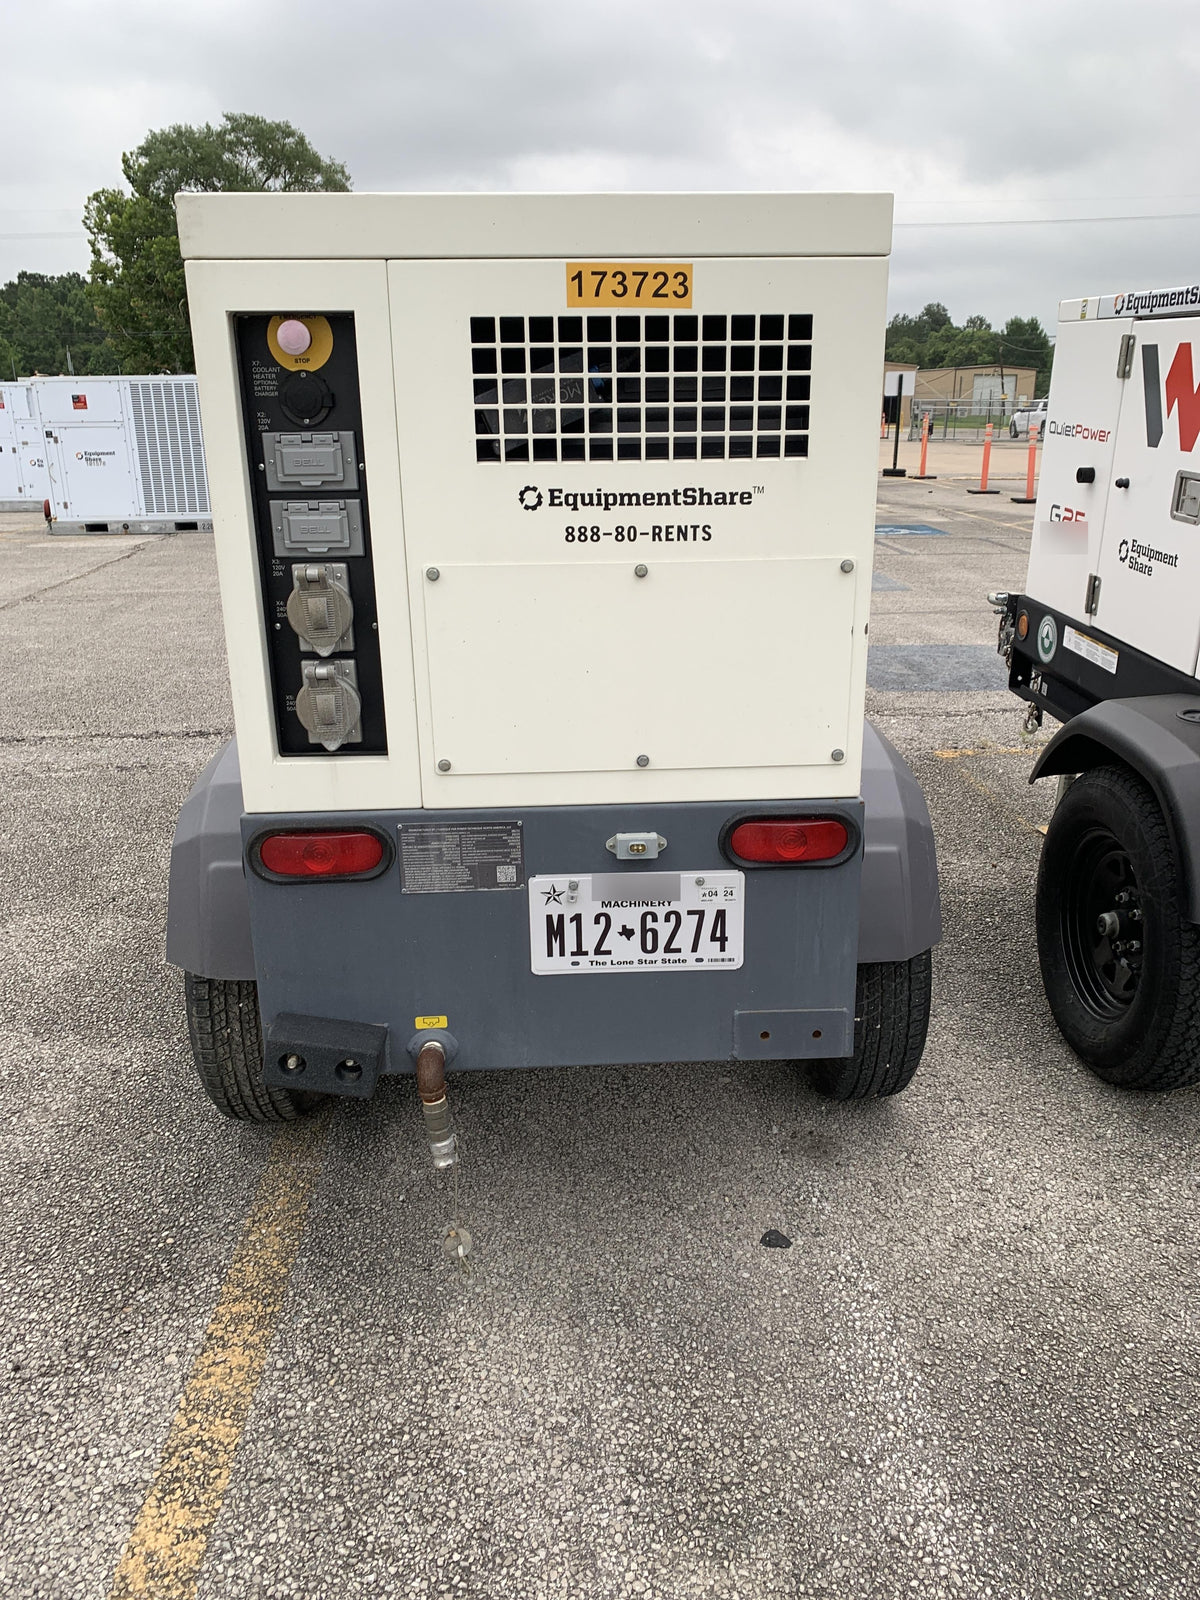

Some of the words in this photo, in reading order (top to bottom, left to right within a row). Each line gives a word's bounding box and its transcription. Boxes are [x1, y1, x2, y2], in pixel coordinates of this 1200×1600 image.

[570, 270, 689, 298] 173723
[1126, 285, 1200, 314] EquipmentS
[1049, 421, 1110, 442] QuietPower
[565, 524, 712, 543] 888-80-RENTS
[1131, 539, 1178, 568] Equipment
[1128, 558, 1152, 576] Share
[601, 900, 672, 908] MACHINERY
[708, 890, 718, 898] 04
[546, 912, 612, 957] M12
[640, 909, 728, 954] 6274
